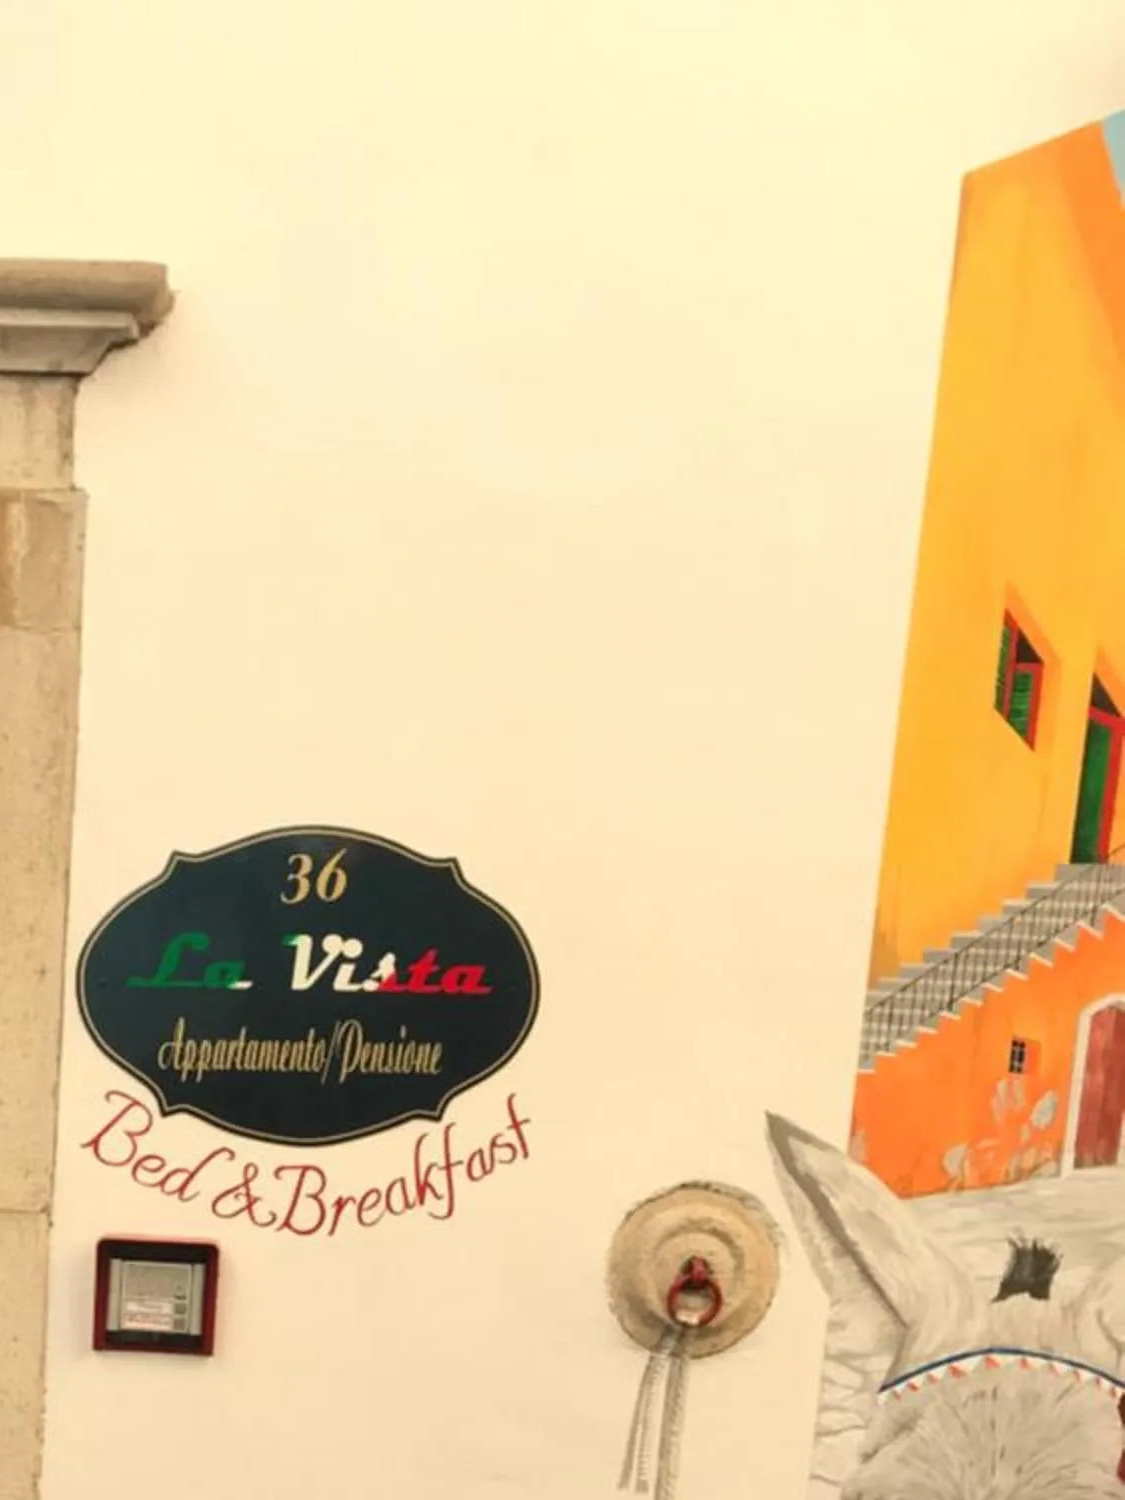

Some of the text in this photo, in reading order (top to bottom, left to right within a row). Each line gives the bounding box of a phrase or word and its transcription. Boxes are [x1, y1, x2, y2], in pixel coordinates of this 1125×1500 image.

[280, 847, 349, 904] 36
[126, 931, 493, 995] La Vista
